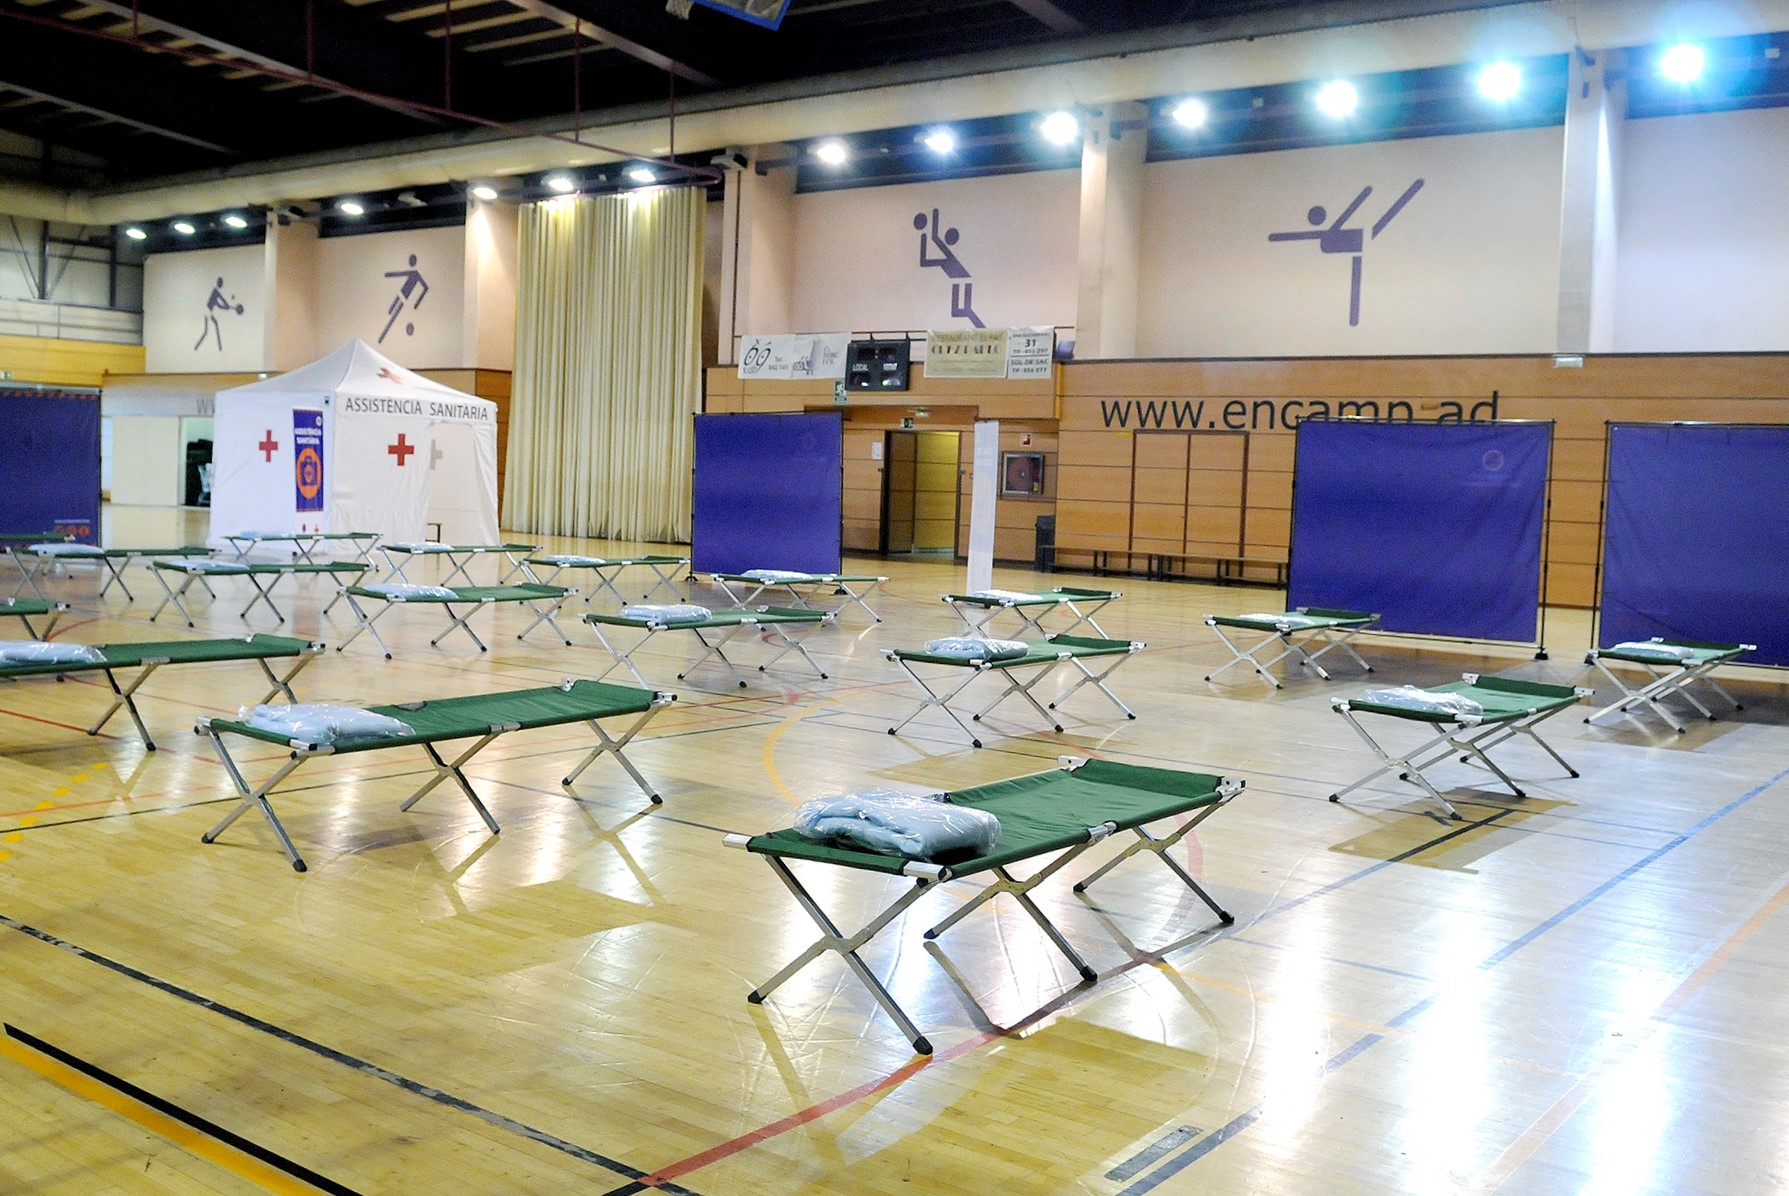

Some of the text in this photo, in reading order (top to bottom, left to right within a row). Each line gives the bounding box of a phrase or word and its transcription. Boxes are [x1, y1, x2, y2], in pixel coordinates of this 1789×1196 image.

[1025, 339, 1036, 347] 31
[852, 363, 869, 371] LOCAL
[345, 396, 488, 421] ASSISTÈNCIA SANITÀRIA
